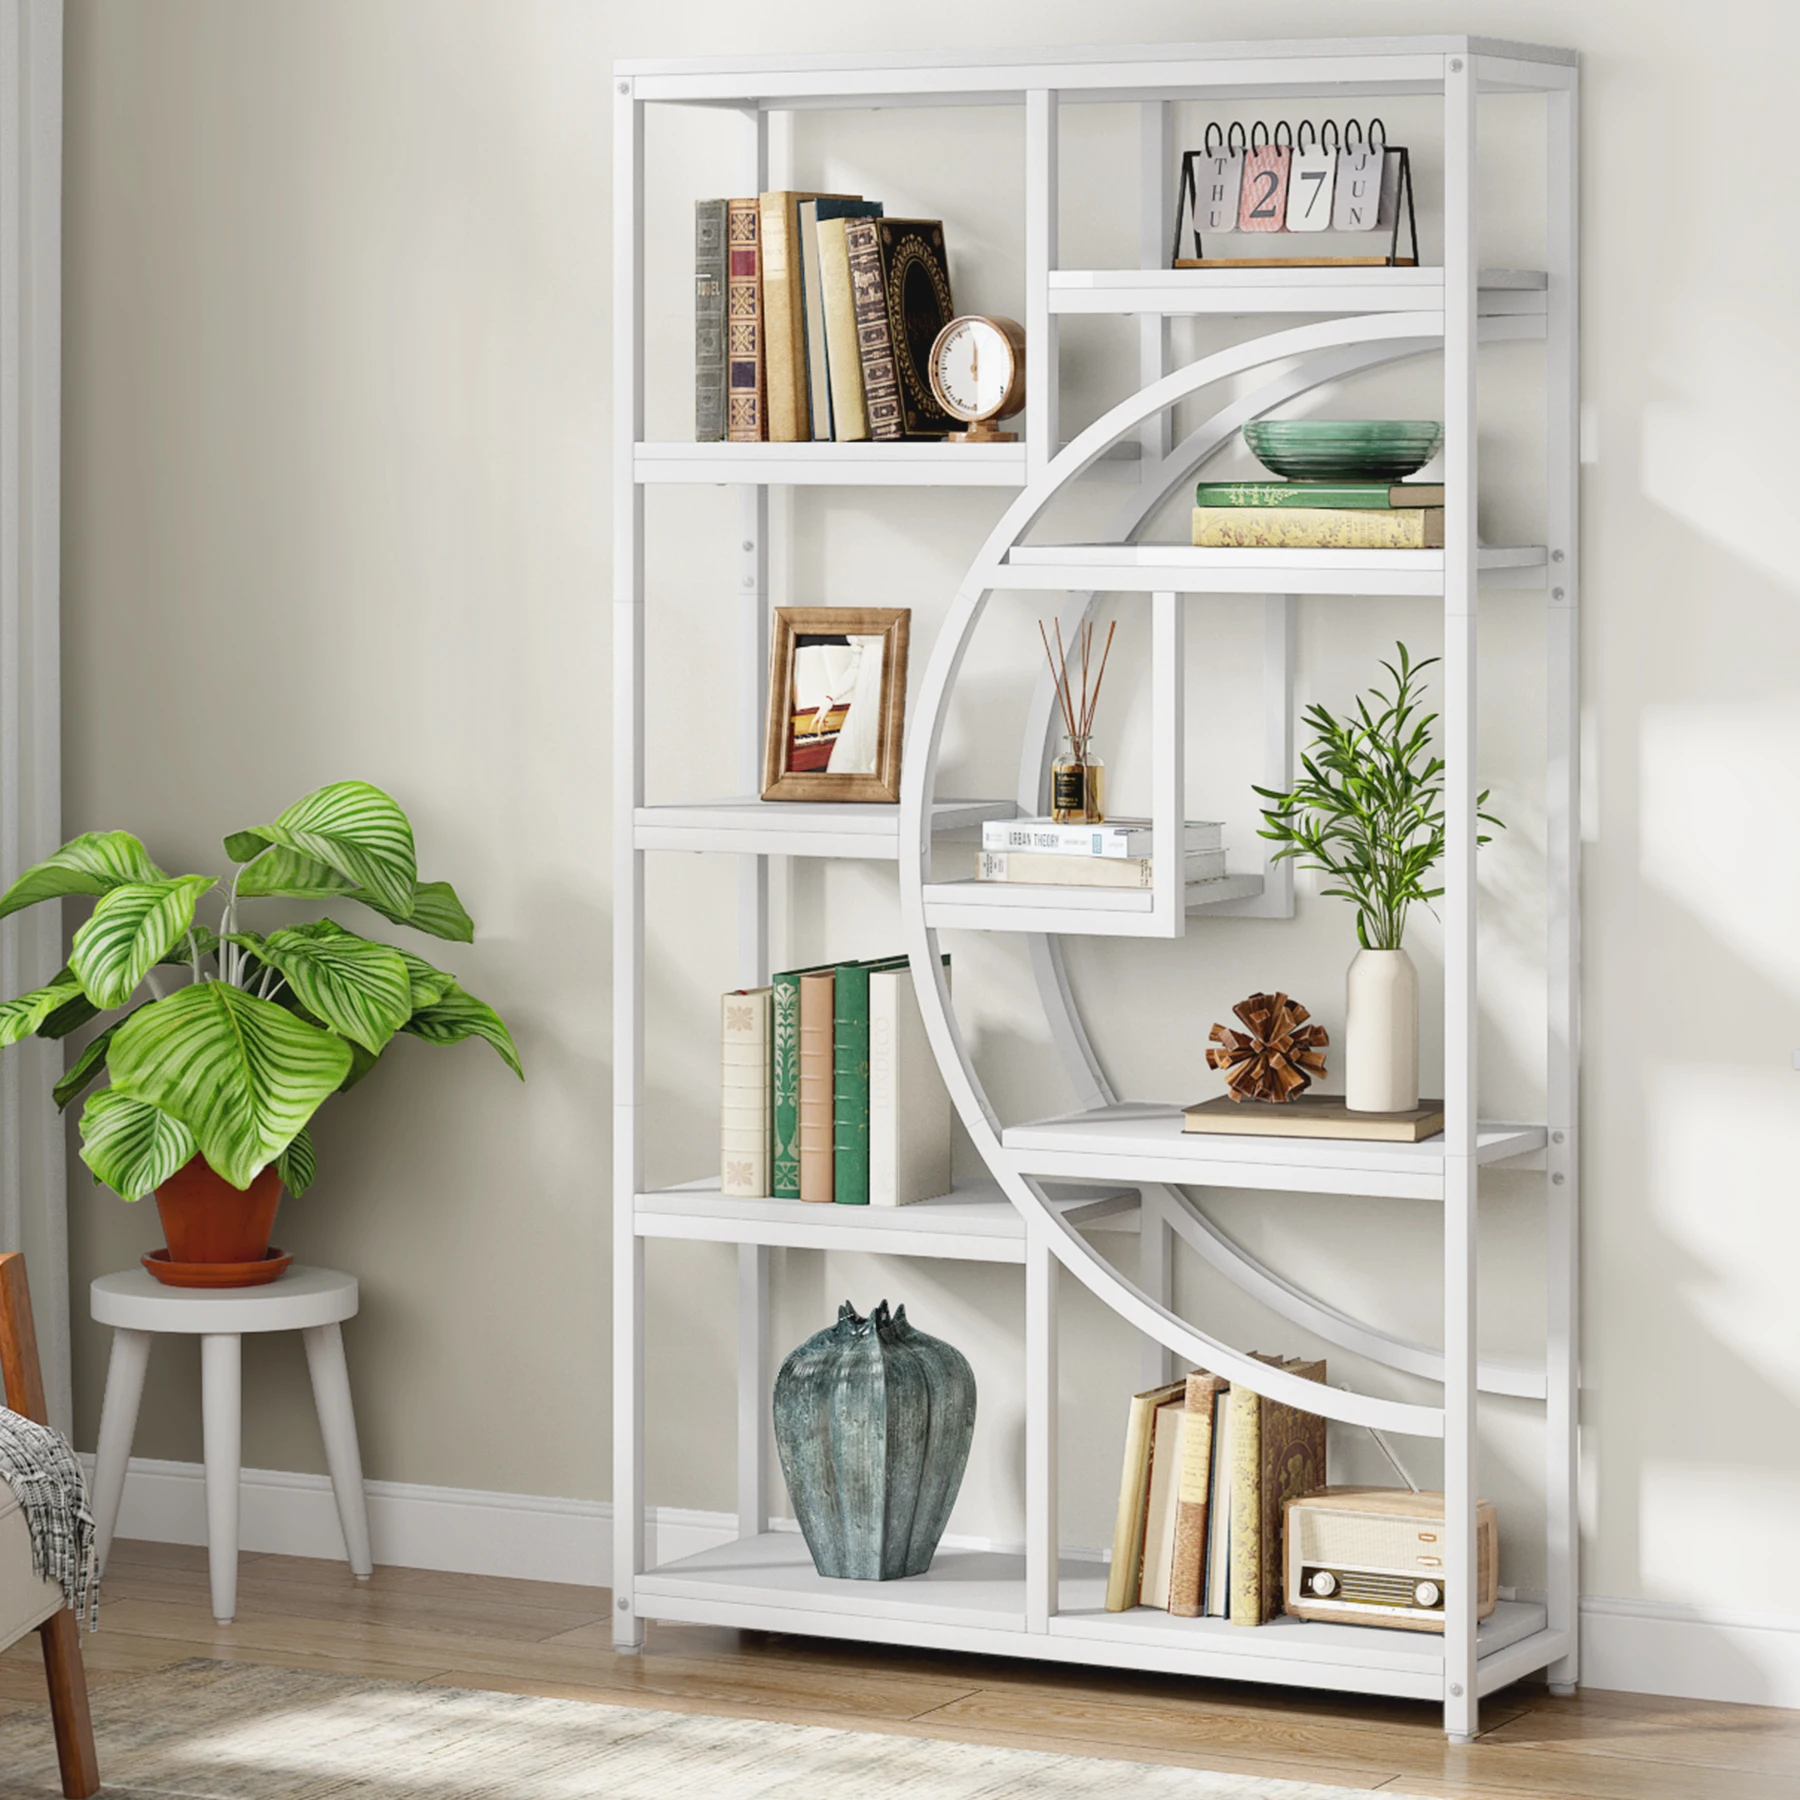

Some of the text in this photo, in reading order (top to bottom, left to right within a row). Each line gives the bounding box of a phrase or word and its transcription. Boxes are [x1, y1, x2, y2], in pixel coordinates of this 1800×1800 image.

[1210, 157, 1227, 228] THU
[1349, 154, 1367, 225] JUN
[1009, 831, 1032, 846] URBAN
[1034, 833, 1060, 848] THEORY
